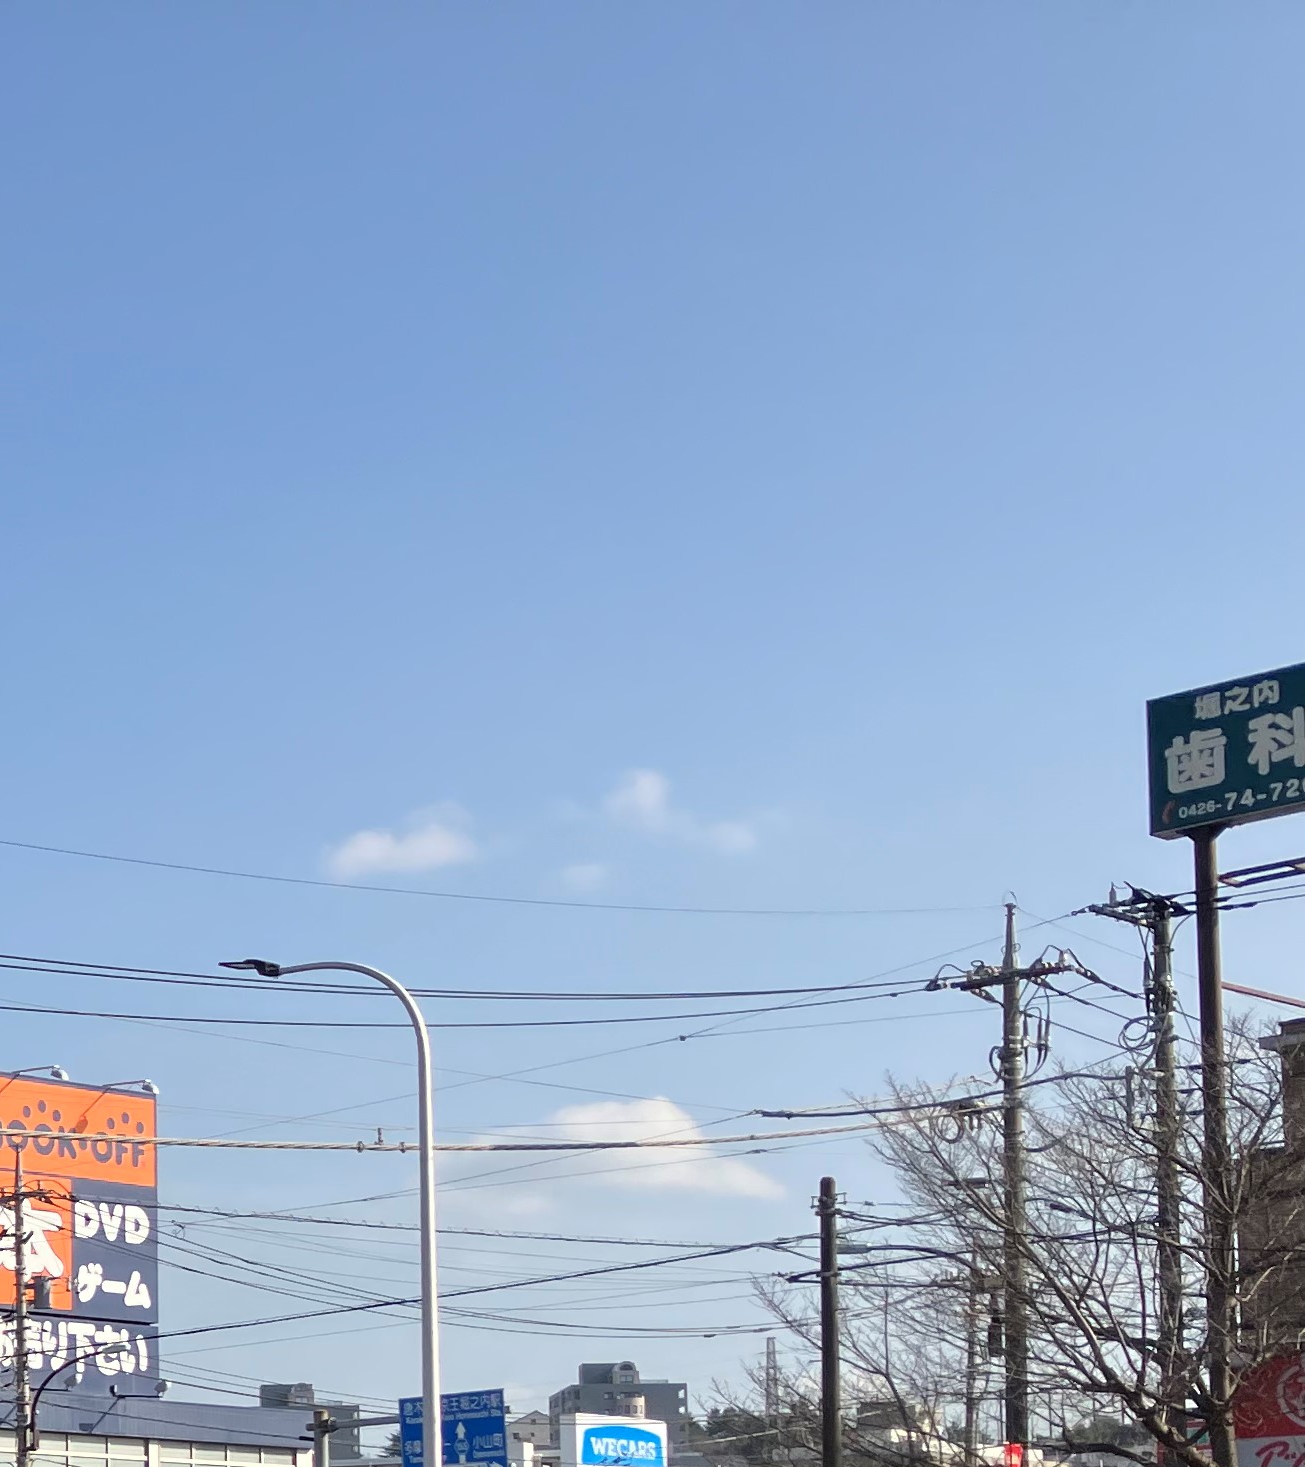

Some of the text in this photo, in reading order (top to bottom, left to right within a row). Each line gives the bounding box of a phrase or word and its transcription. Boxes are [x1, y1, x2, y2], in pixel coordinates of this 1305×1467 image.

[1194, 680, 1280, 720] 堀之内
[1178, 778, 1305, 819] 0426-74-72
[74, 1200, 150, 1244] DVD
[77, 1263, 151, 1309] ゲーム
[590, 1437, 656, 1460] WECARS
